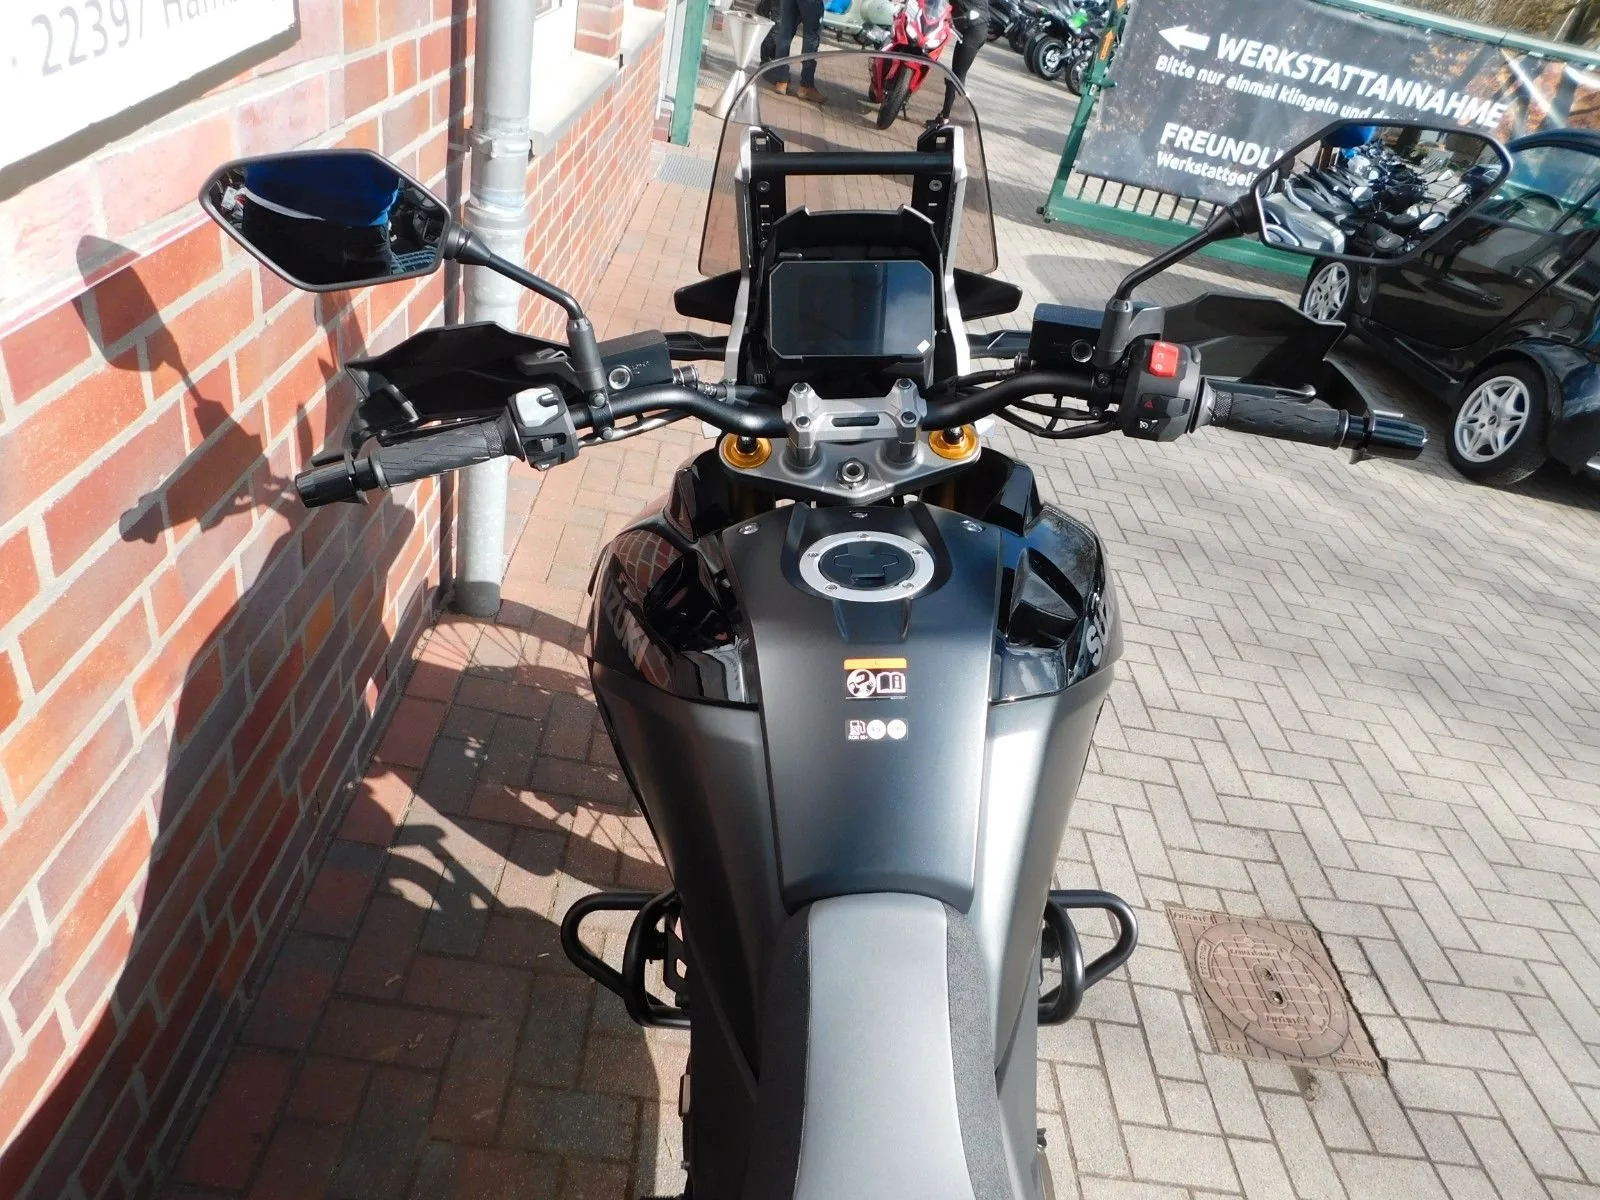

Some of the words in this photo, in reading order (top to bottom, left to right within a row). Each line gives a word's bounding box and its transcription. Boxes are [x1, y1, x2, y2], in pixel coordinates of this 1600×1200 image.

[1155, 55, 1196, 79] Bitte
[1197, 68, 1225, 86] nur
[1226, 74, 1280, 100] einmal
[1277, 84, 1339, 115] klingeln
[1340, 104, 1373, 119] und
[1217, 33, 1509, 128] WERKSTATTANNAHME
[1157, 151, 1258, 187] Werkstattgel
